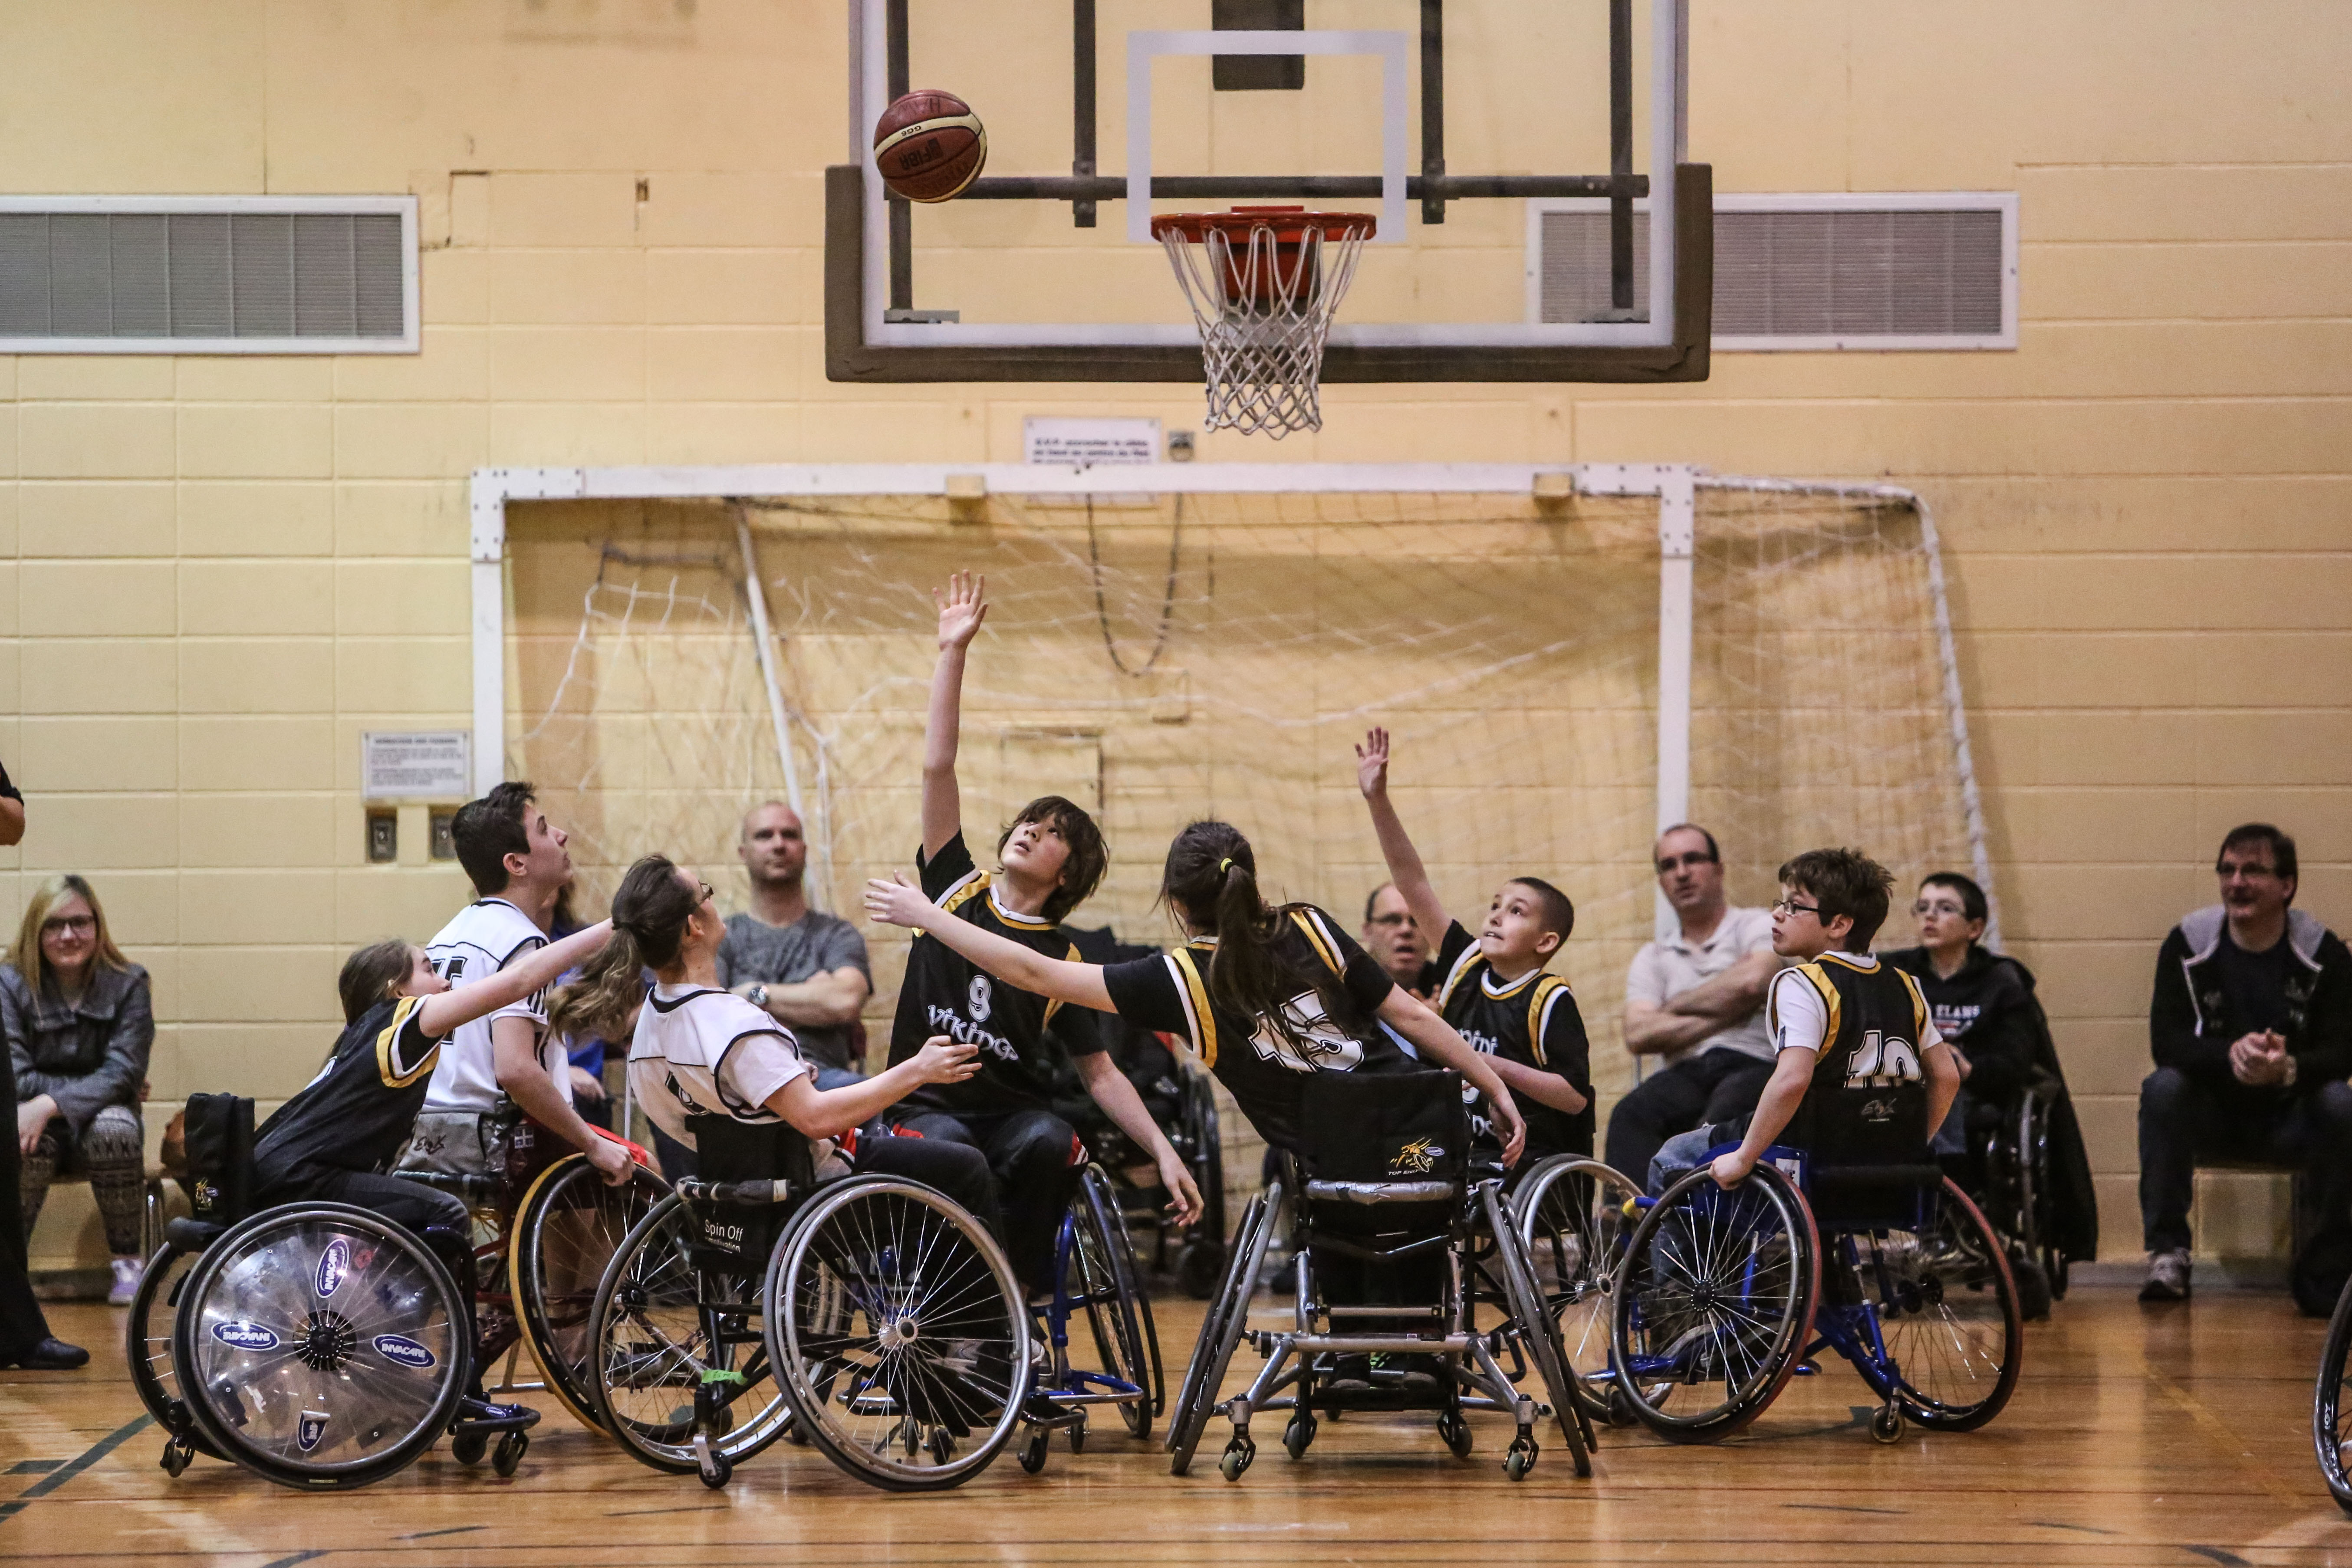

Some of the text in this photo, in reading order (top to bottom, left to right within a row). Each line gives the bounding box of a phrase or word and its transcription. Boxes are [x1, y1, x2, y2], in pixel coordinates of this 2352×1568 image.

[901, 125, 921, 136] GG6
[898, 146, 932, 170] FIBA
[969, 975, 991, 1022] 9
[1844, 1030, 1922, 1088] 10
[705, 1219, 743, 1242] Spin Off
[324, 1248, 337, 1290] INVACARE
[223, 1331, 270, 1341] INVACARE
[382, 1343, 425, 1358] INVACARE
